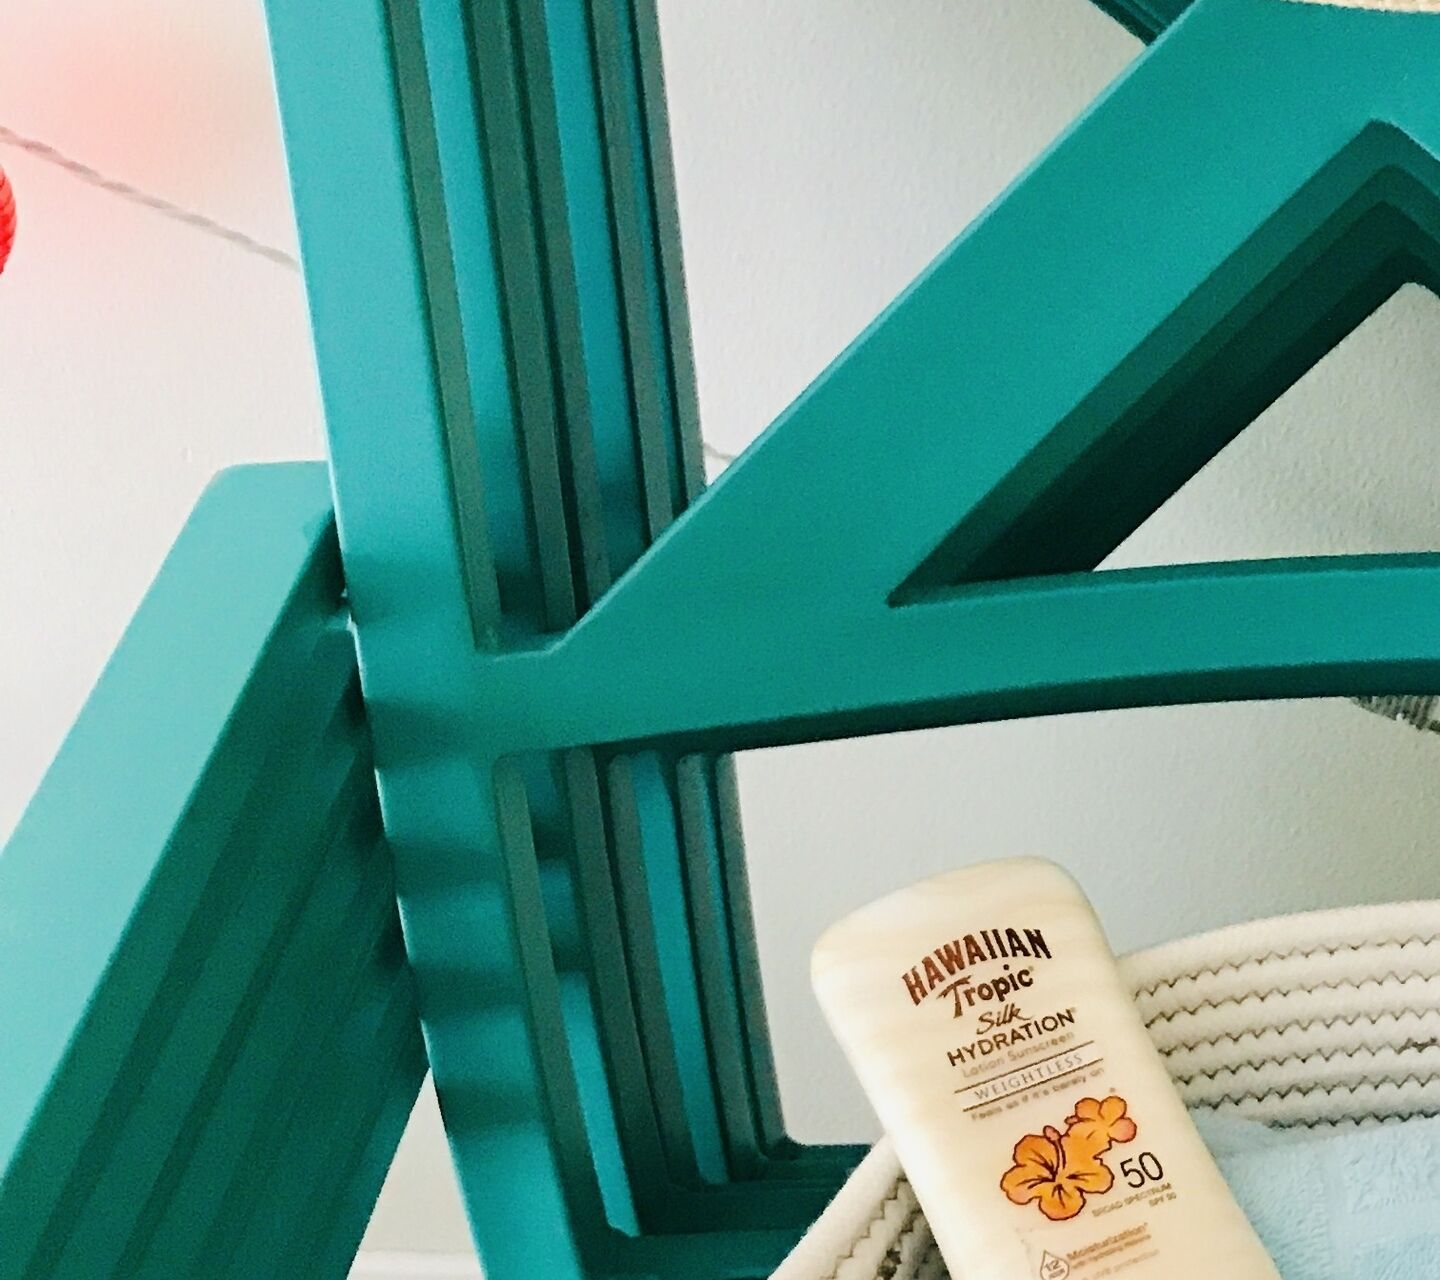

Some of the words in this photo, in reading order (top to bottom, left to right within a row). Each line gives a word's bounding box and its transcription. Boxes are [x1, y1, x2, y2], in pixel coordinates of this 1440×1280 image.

[901, 927, 1053, 1006] HAWAIIAN
[936, 964, 1034, 1018] Tropic
[947, 1008, 1076, 1066] HYDRATION
[976, 1003, 1033, 1035] Silk
[961, 1057, 1005, 1079] Lotion
[1006, 1031, 1075, 1062] Sunscreen
[974, 1053, 1083, 1100] WEIGHTLESS
[1120, 1151, 1164, 1188] 50
[1045, 1260, 1060, 1272] 12
